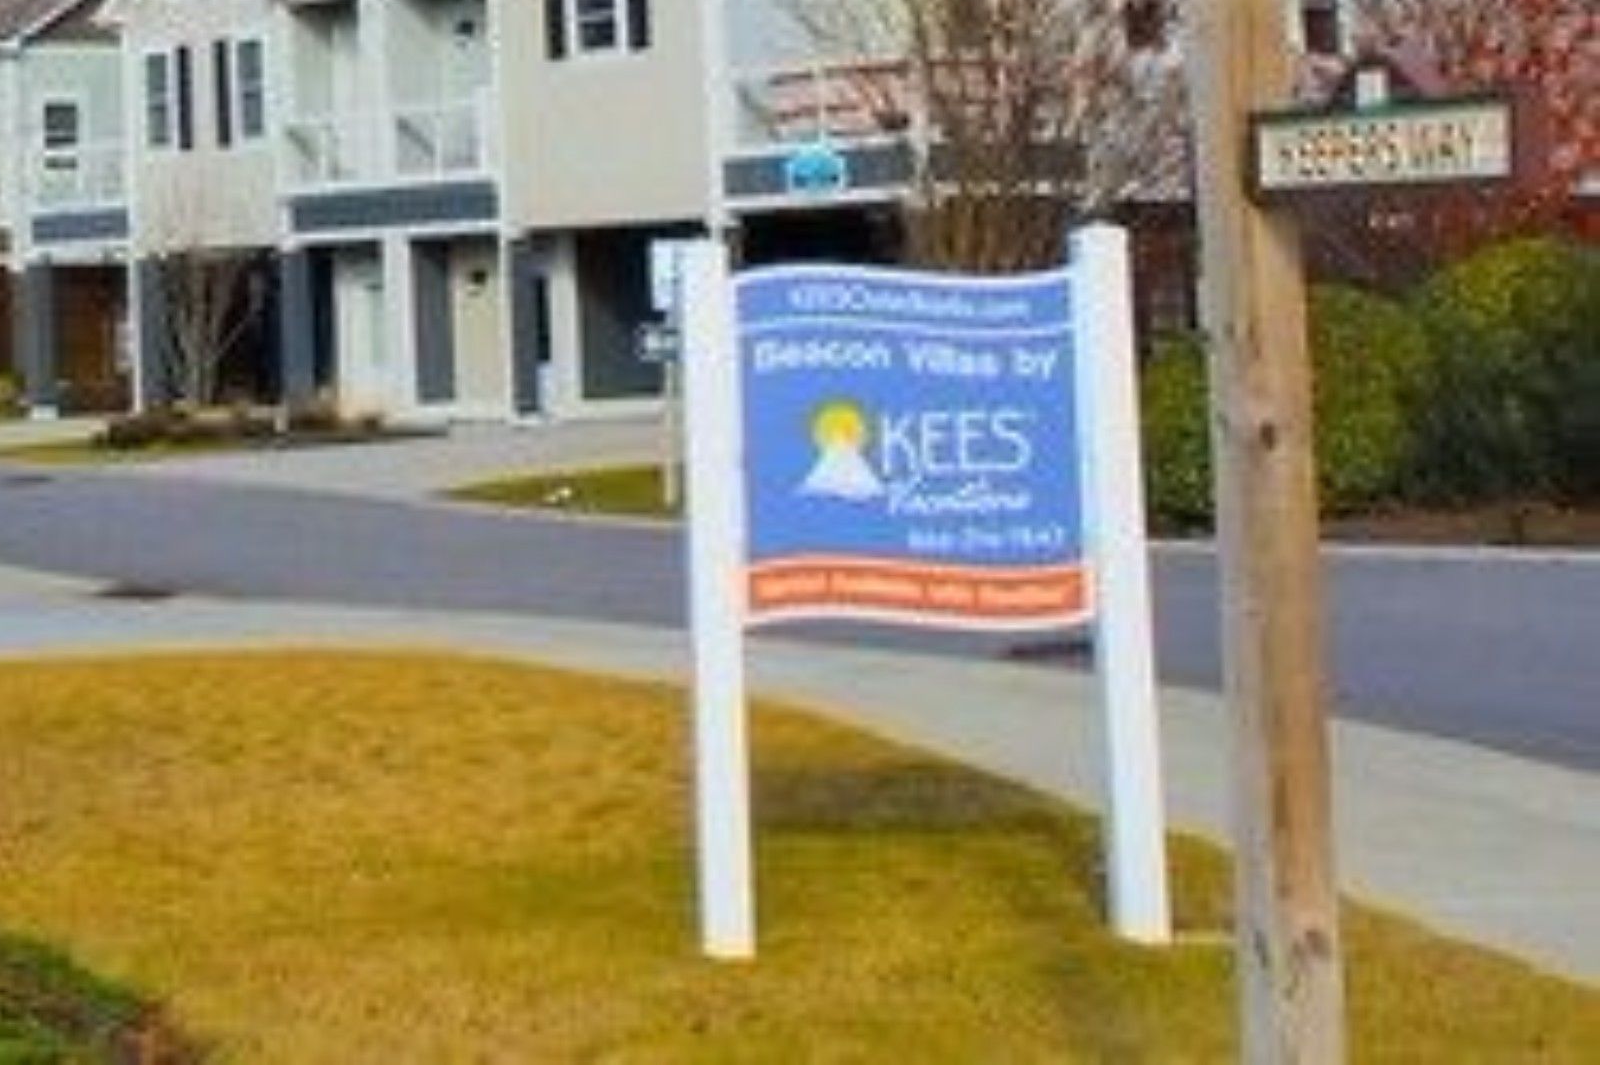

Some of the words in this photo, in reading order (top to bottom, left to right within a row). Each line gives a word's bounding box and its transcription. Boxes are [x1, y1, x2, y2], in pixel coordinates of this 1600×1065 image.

[1408, 119, 1477, 169] WAY
[753, 339, 890, 372] Beacon
[905, 344, 998, 377] Villas
[1012, 345, 1058, 380] by
[878, 410, 1033, 474] KEES
